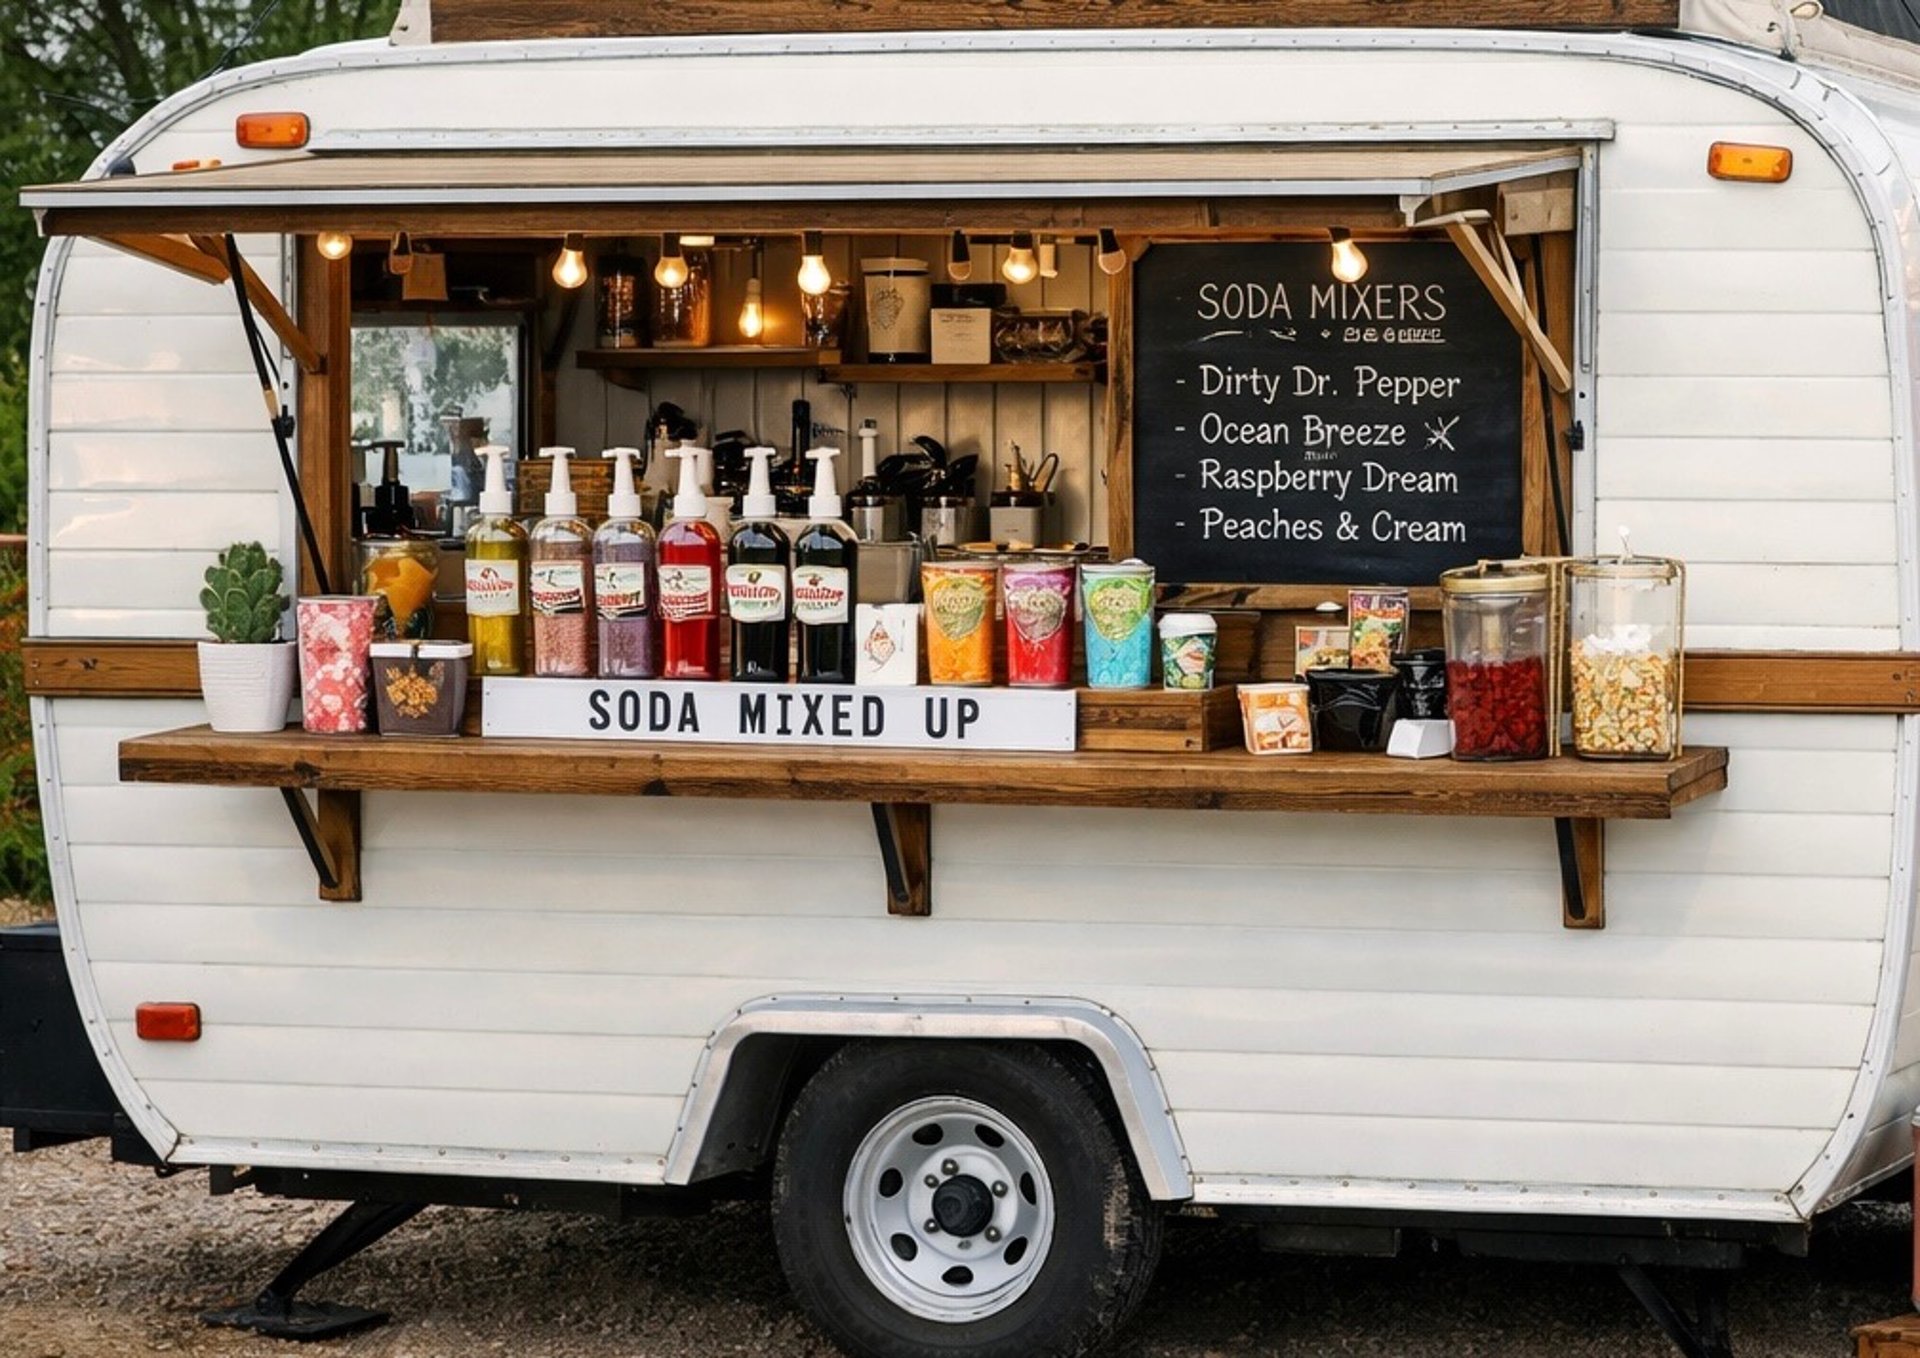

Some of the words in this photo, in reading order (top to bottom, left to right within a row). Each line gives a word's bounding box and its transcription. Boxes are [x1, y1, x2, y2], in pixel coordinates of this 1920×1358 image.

[1197, 282, 1292, 320] SODA
[1310, 283, 1447, 321] MIXERS
[1200, 364, 1281, 405] Dirty
[1292, 365, 1338, 397] Dr.
[1354, 366, 1461, 406] Pepper
[1200, 412, 1289, 445] Ocean
[1302, 414, 1406, 449] Breeze
[1200, 458, 1353, 501] Raspberry
[1361, 461, 1459, 494] Dream
[1200, 507, 1324, 541] Peaches
[1336, 510, 1360, 541] &
[1371, 509, 1466, 543] Cream
[588, 688, 701, 734] SODA
[738, 692, 886, 738] MIXED
[924, 696, 981, 740] UP
